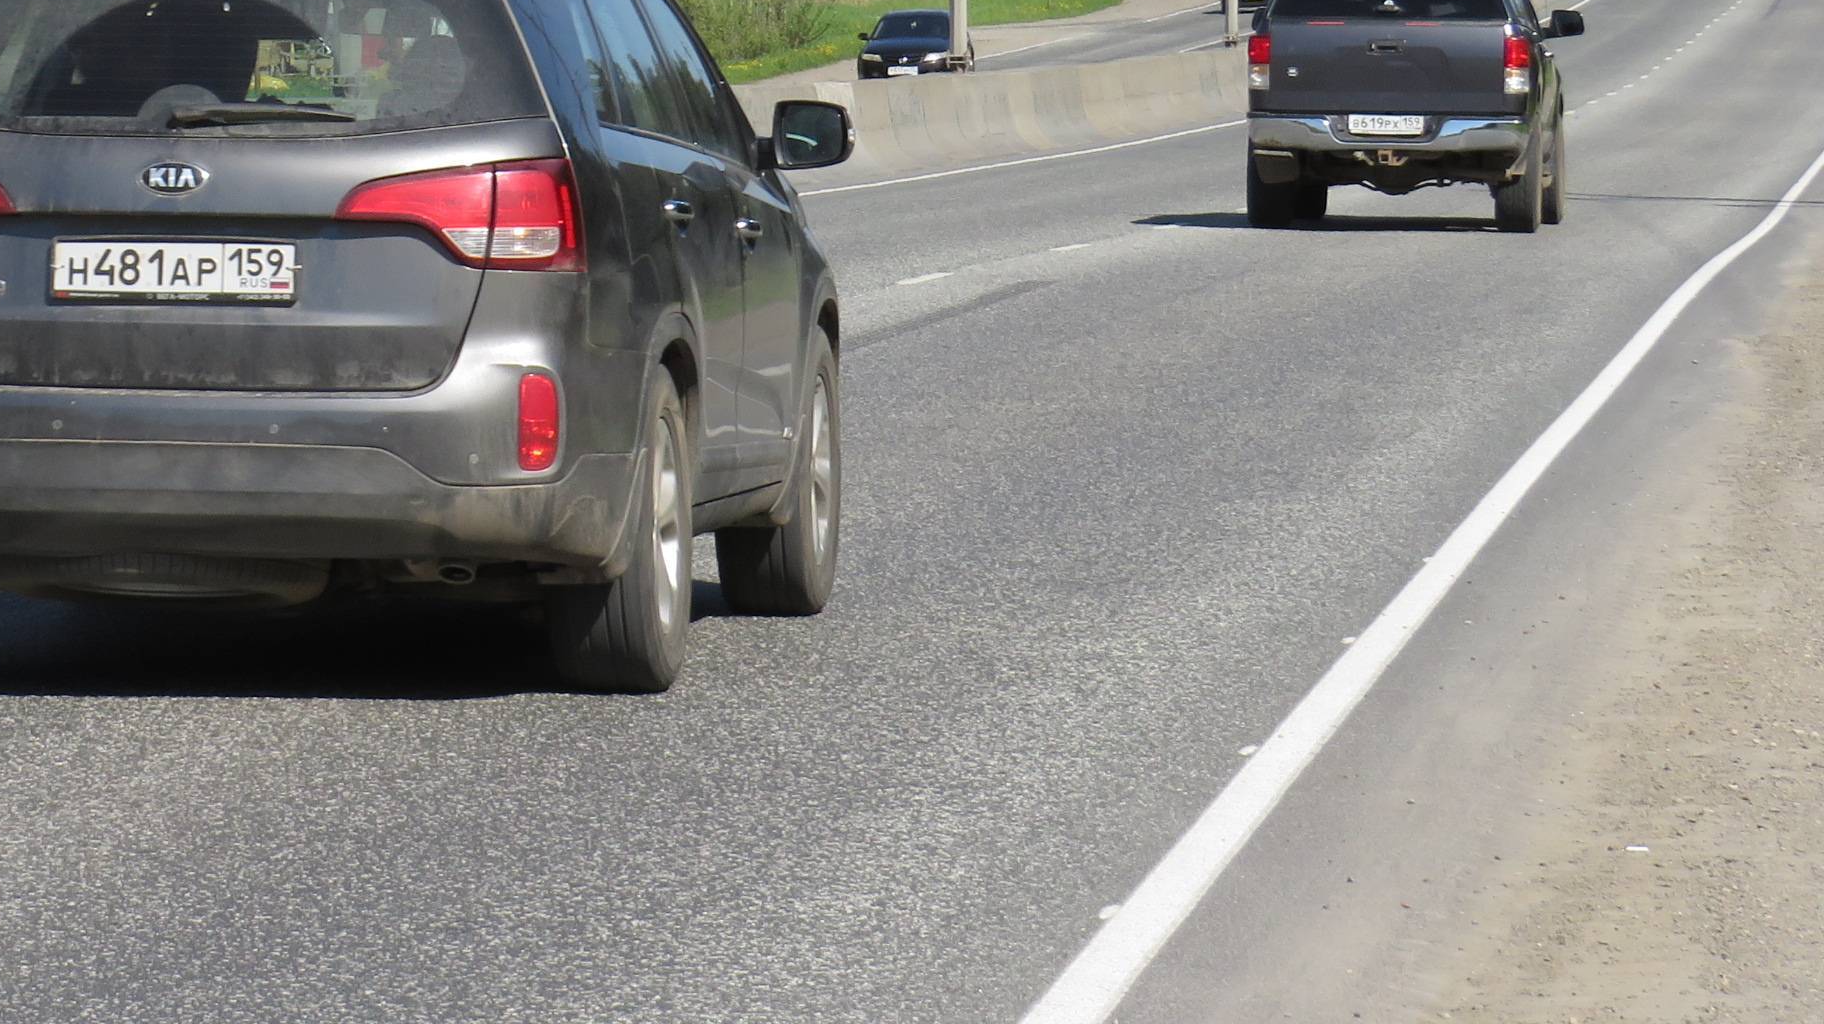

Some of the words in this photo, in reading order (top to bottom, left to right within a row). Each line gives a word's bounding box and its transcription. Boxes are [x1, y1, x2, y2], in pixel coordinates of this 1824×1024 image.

[1401, 117, 1420, 127] 159
[149, 167, 196, 188] KIA
[68, 248, 217, 286] Н481АР
[228, 248, 284, 276] 159
[240, 277, 268, 288] RUS
